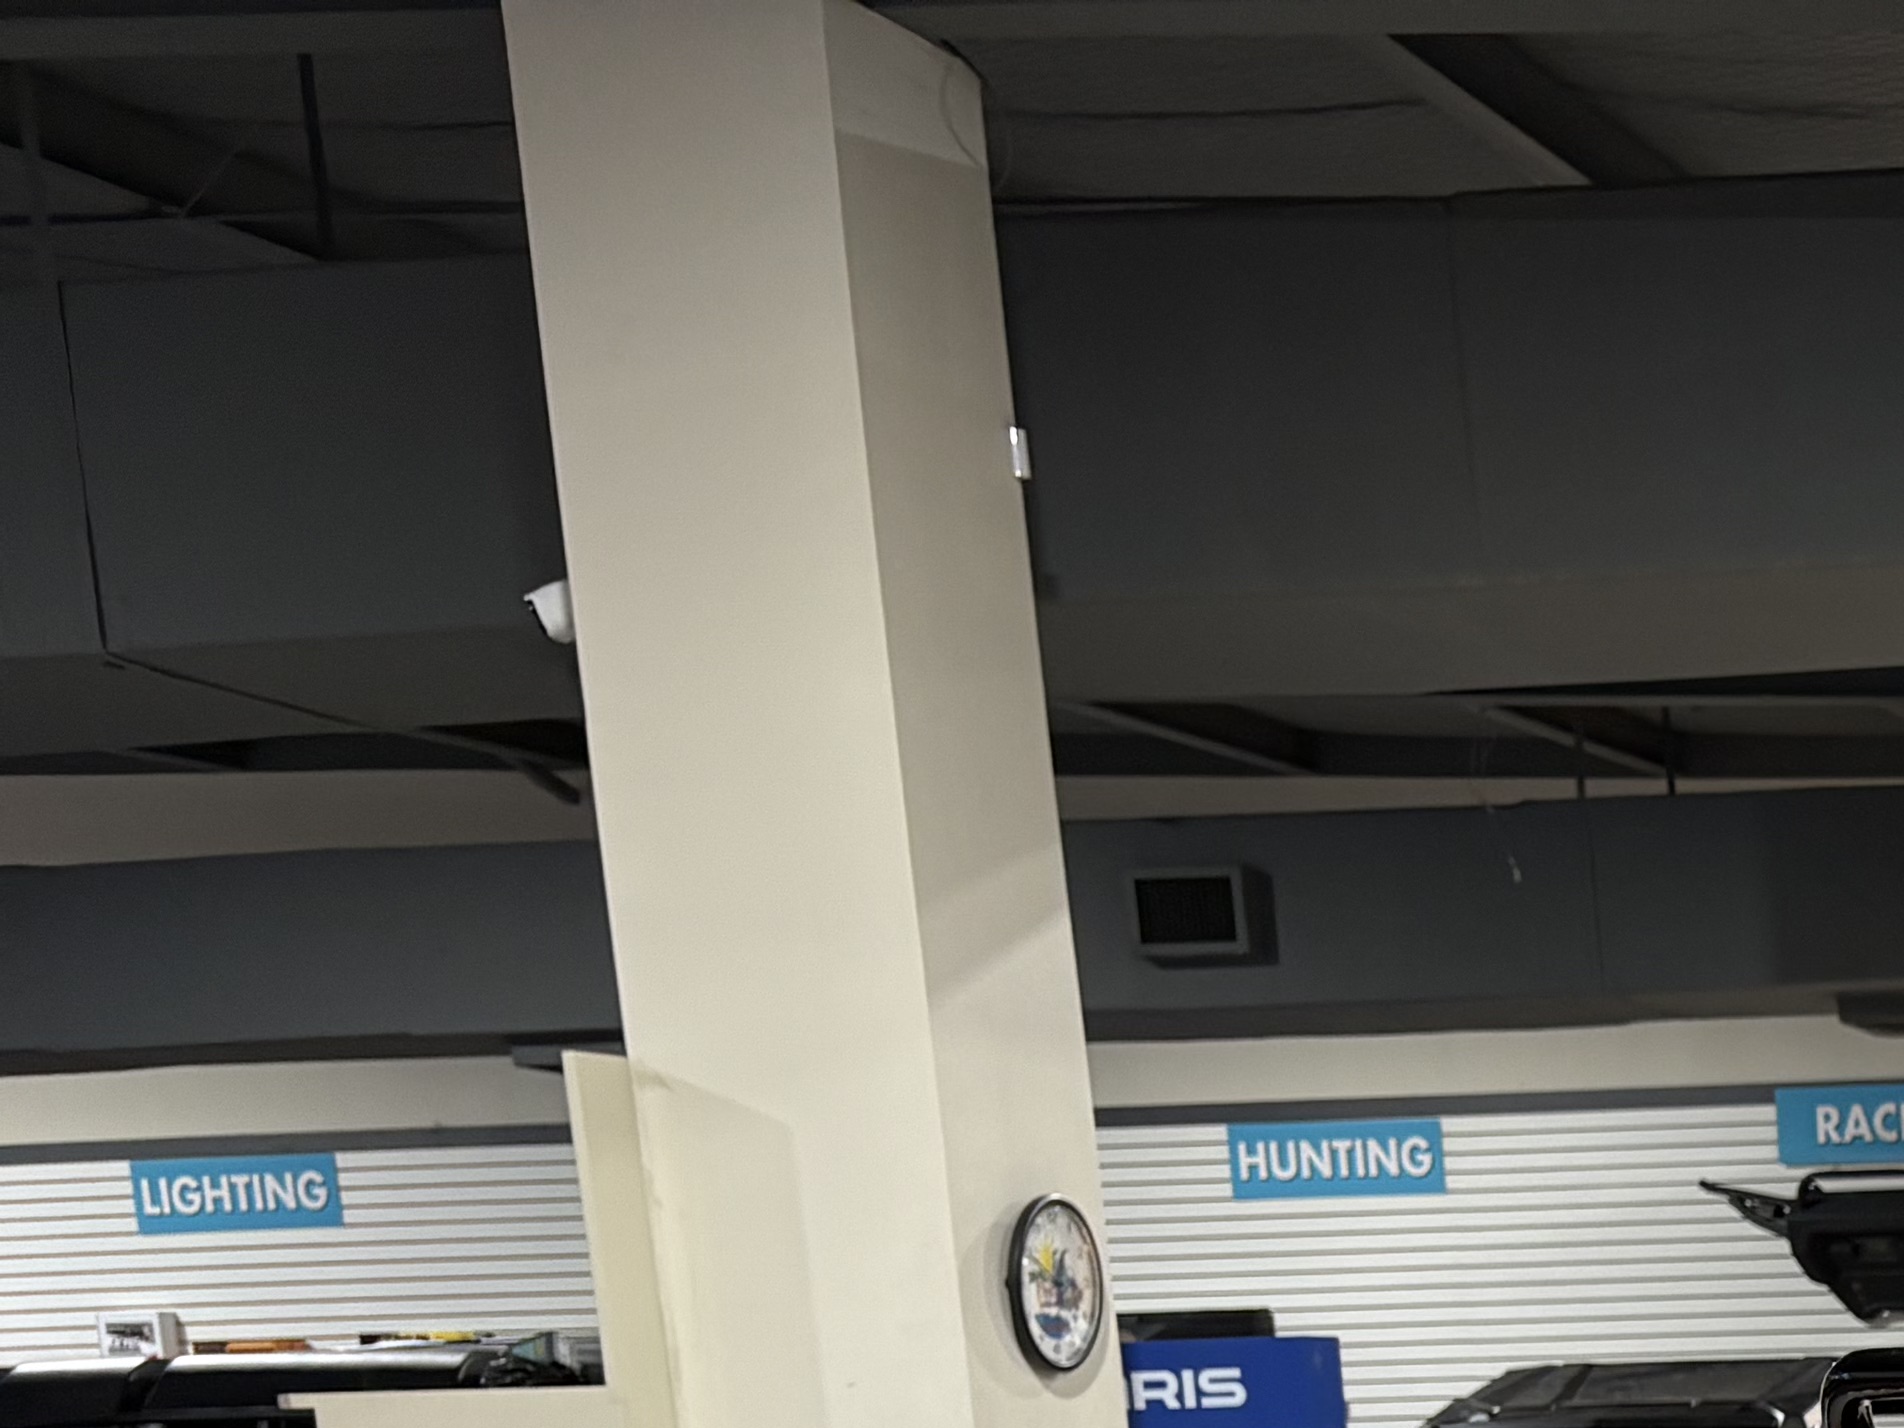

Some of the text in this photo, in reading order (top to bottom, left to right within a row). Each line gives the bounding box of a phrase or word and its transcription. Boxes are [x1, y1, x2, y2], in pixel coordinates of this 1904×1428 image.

[1237, 1136, 1434, 1181] HUNTING
[141, 1169, 328, 1218] LIGHTING
[1124, 1366, 1248, 1412] RIS
